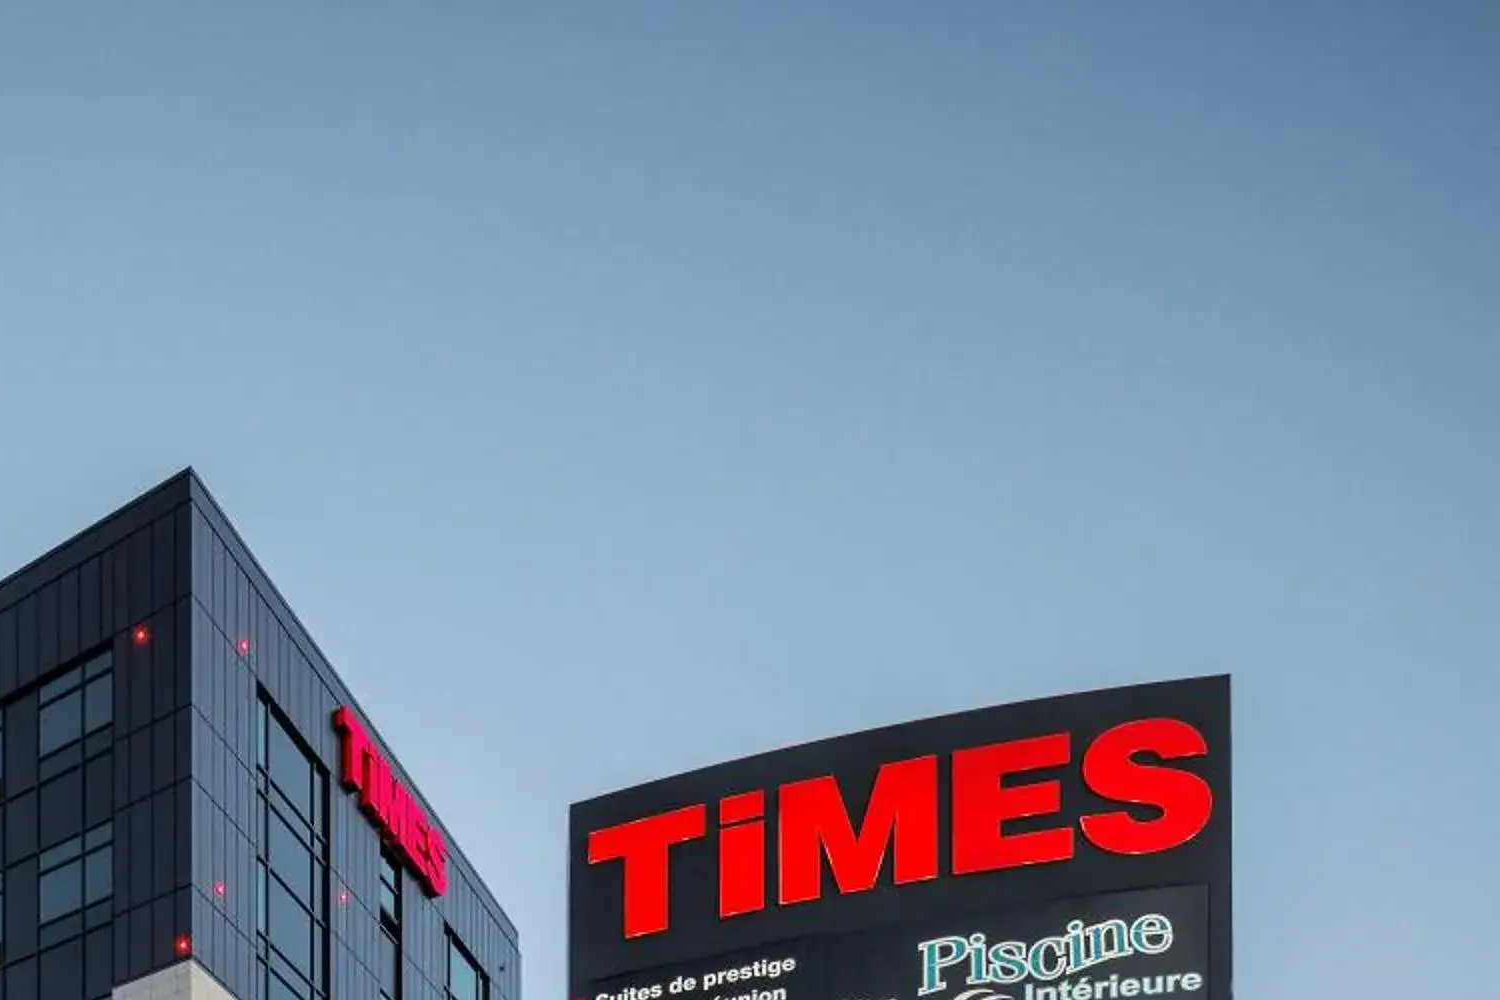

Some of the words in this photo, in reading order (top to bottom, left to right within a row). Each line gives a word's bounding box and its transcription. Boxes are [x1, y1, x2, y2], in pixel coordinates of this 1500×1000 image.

[669, 976, 697, 994] de
[703, 957, 797, 991] prestige
[917, 913, 1173, 996] Piscine
